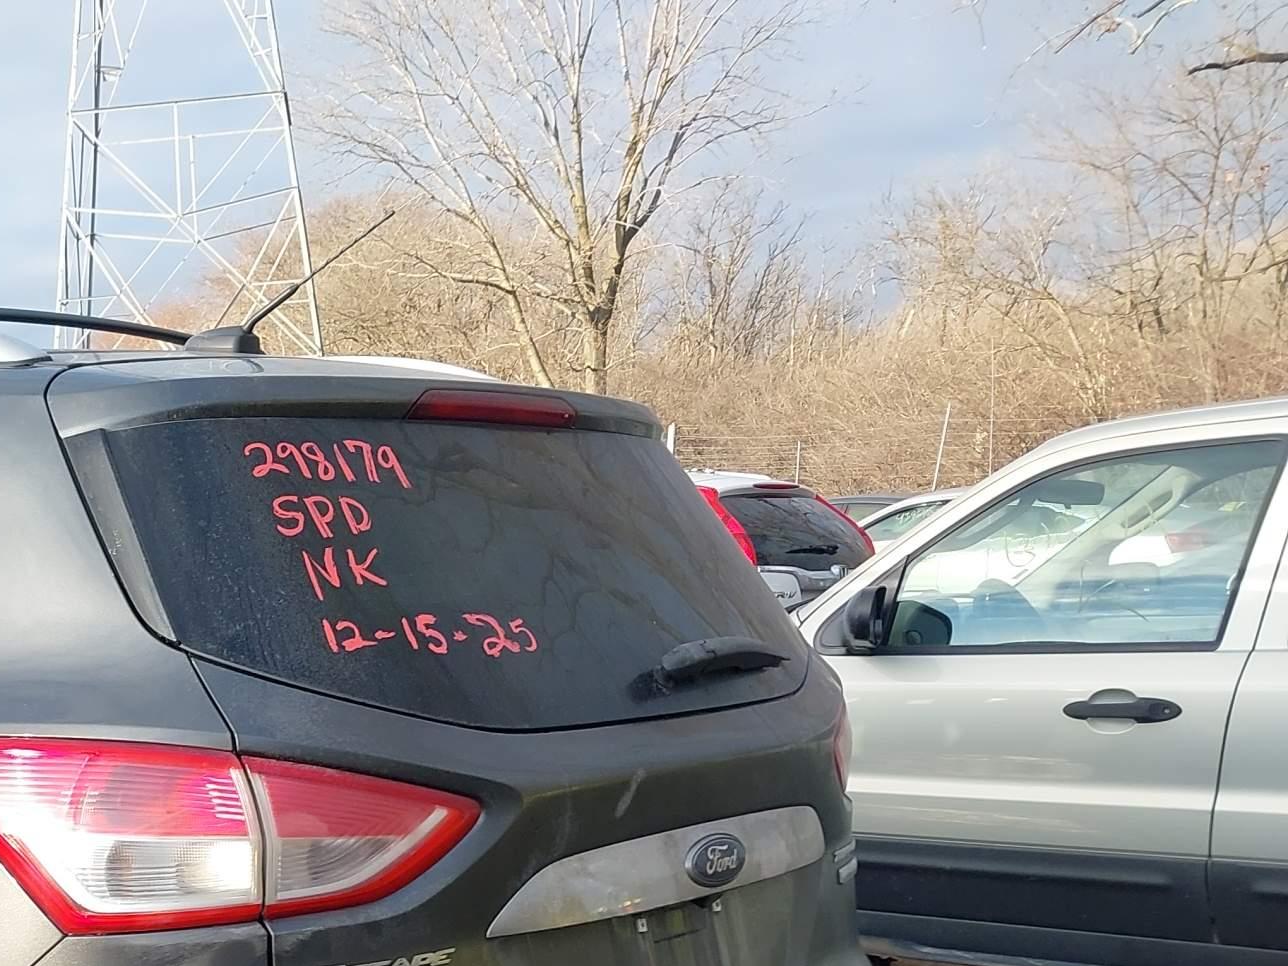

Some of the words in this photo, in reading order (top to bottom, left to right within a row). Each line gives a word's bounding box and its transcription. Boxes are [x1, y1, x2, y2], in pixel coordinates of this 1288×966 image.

[243, 438, 411, 488] 298179
[272, 495, 372, 538] SPD
[706, 844, 737, 875] Ford
